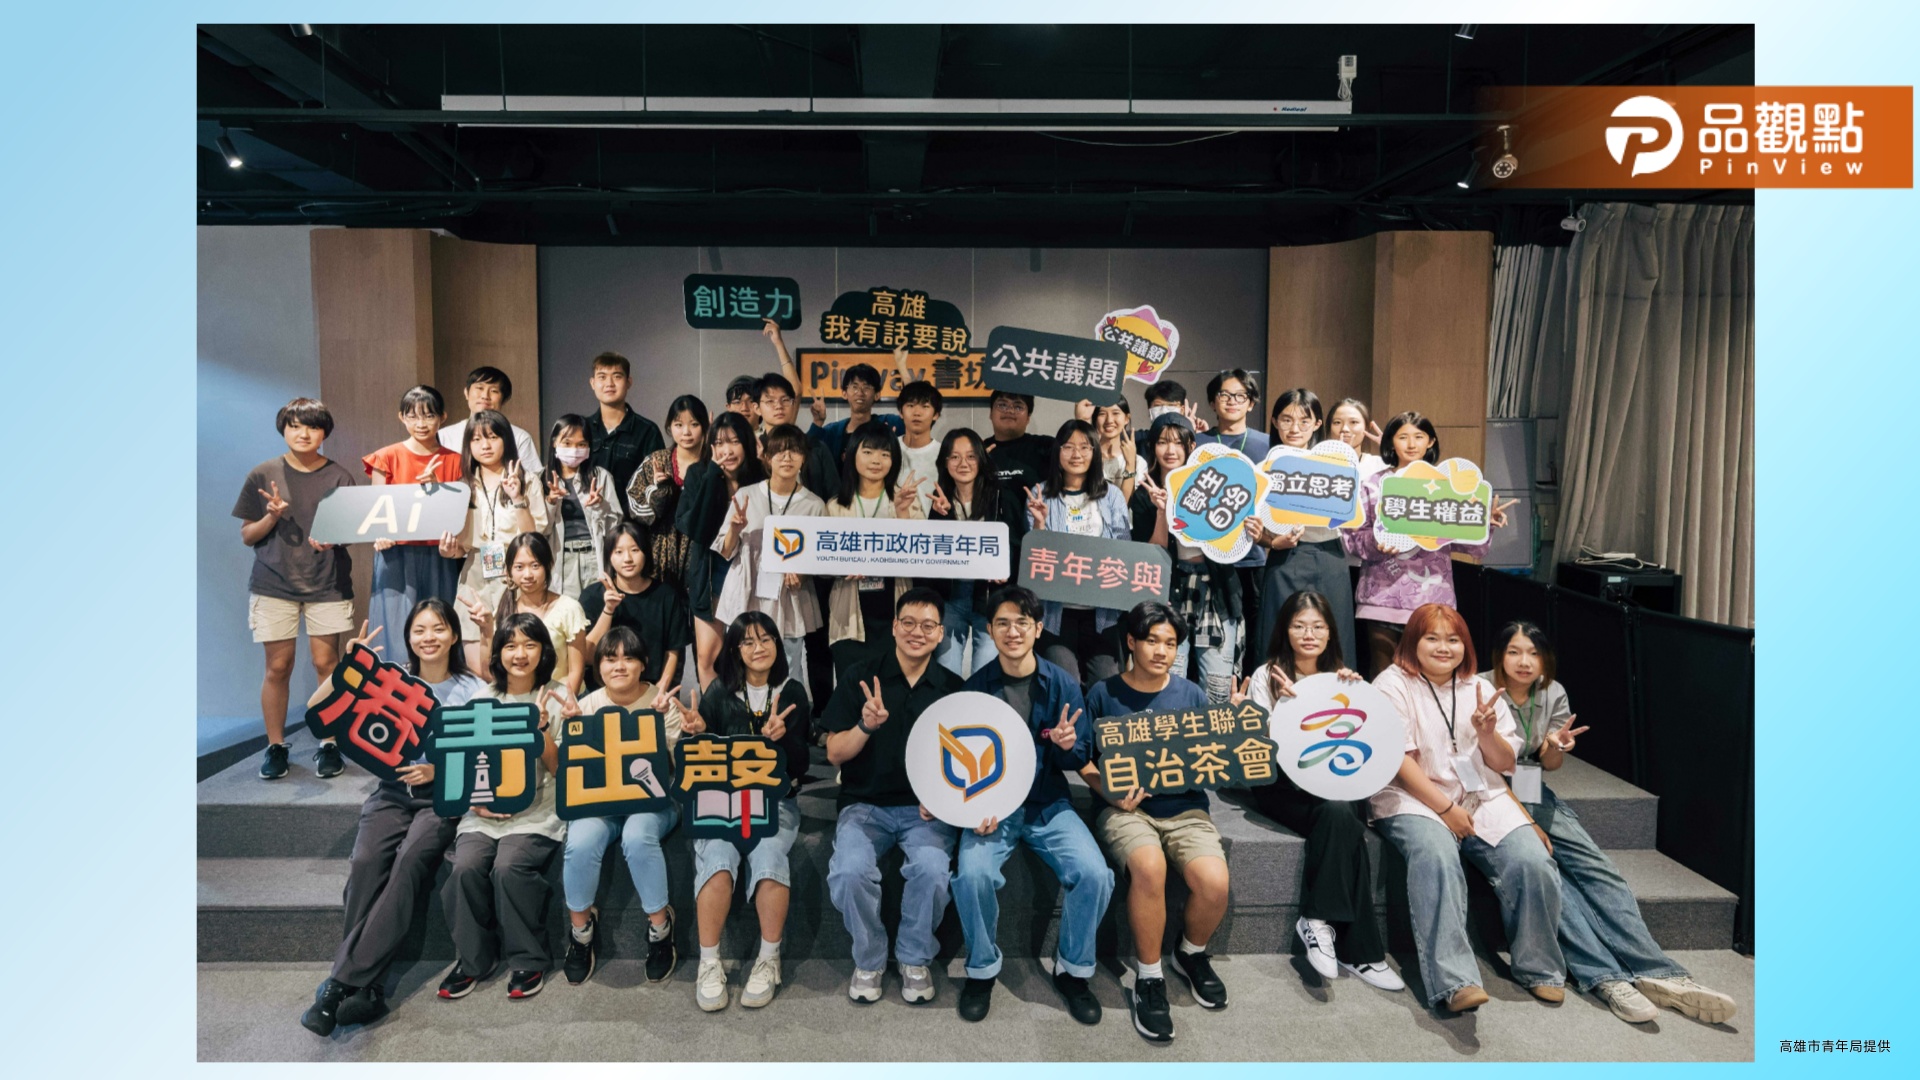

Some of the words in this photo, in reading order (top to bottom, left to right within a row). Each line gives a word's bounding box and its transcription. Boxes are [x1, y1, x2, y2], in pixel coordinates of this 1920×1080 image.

[693, 285, 795, 320] 創造力
[871, 289, 926, 321] 高雄
[824, 316, 967, 355] 我有話要說
[1102, 324, 1167, 362] 公共議題
[991, 344, 1119, 390] 公共議題
[357, 489, 426, 535] Ai
[1383, 496, 1487, 526] 學生權益
[816, 530, 1000, 557] 高雄市政府青年局
[1028, 546, 1163, 596] 青年參與
[321, 647, 434, 767] 港
[1098, 706, 1264, 746] 高雄學生聯合
[435, 702, 535, 801] 青
[566, 713, 658, 807] 出
[1104, 740, 1273, 791] 自治茶會
